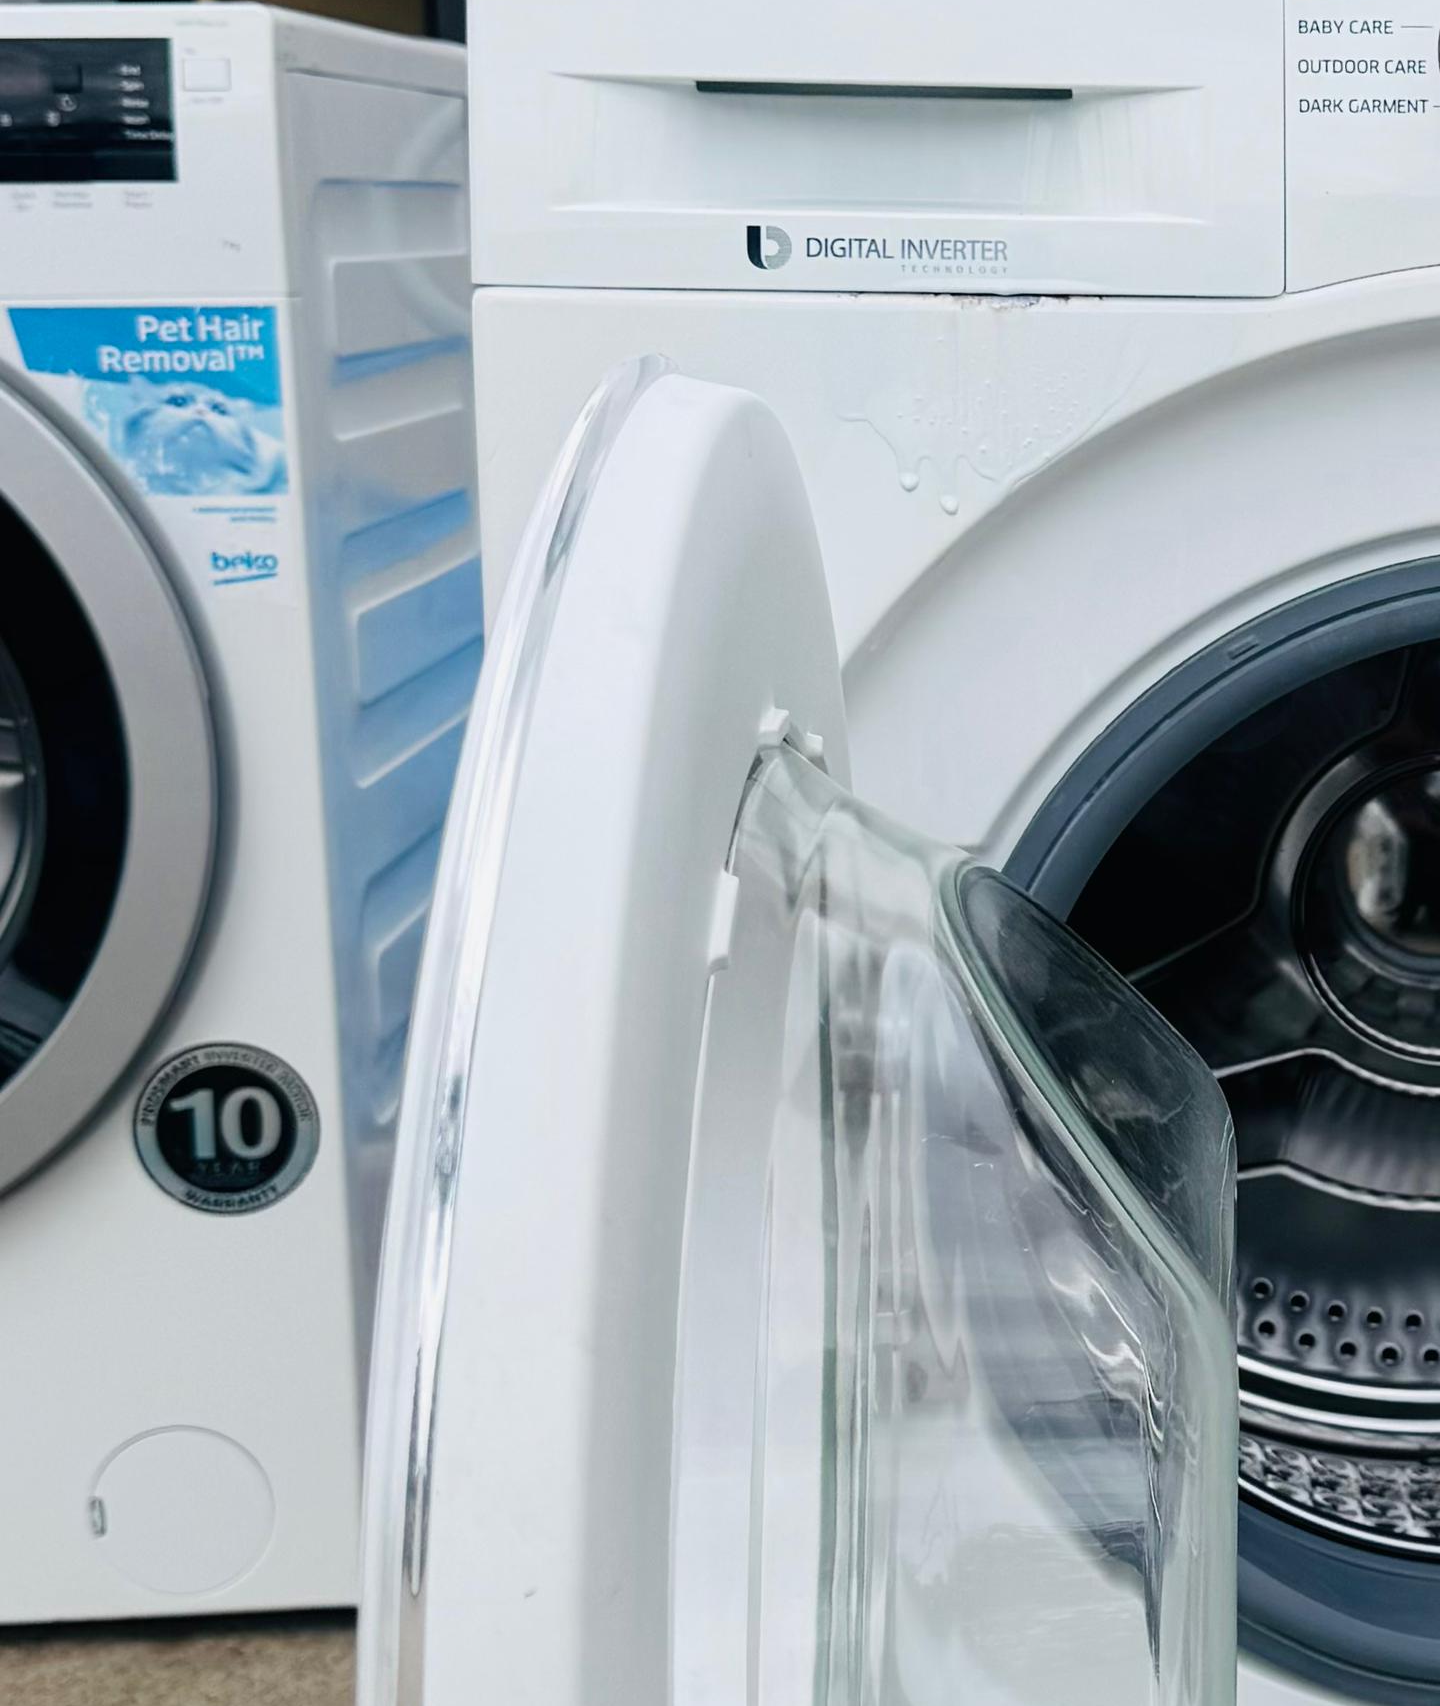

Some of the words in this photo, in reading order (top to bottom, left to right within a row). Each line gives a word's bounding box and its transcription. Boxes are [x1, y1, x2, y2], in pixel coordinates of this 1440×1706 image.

[1298, 20, 1345, 35] BABY
[1348, 20, 1394, 35] CARE
[1297, 59, 1380, 75] OUTDOOR
[1384, 60, 1427, 75] CARE
[1299, 99, 1343, 114] DARK
[1348, 99, 1428, 114] GARMENT
[805, 237, 894, 259] DIGITAL
[901, 238, 1008, 262] INVERTER
[900, 263, 1008, 275] TECHNOLOGY
[137, 315, 193, 342] Pet
[199, 315, 264, 341] Hair
[169, 1085, 282, 1160] 10
